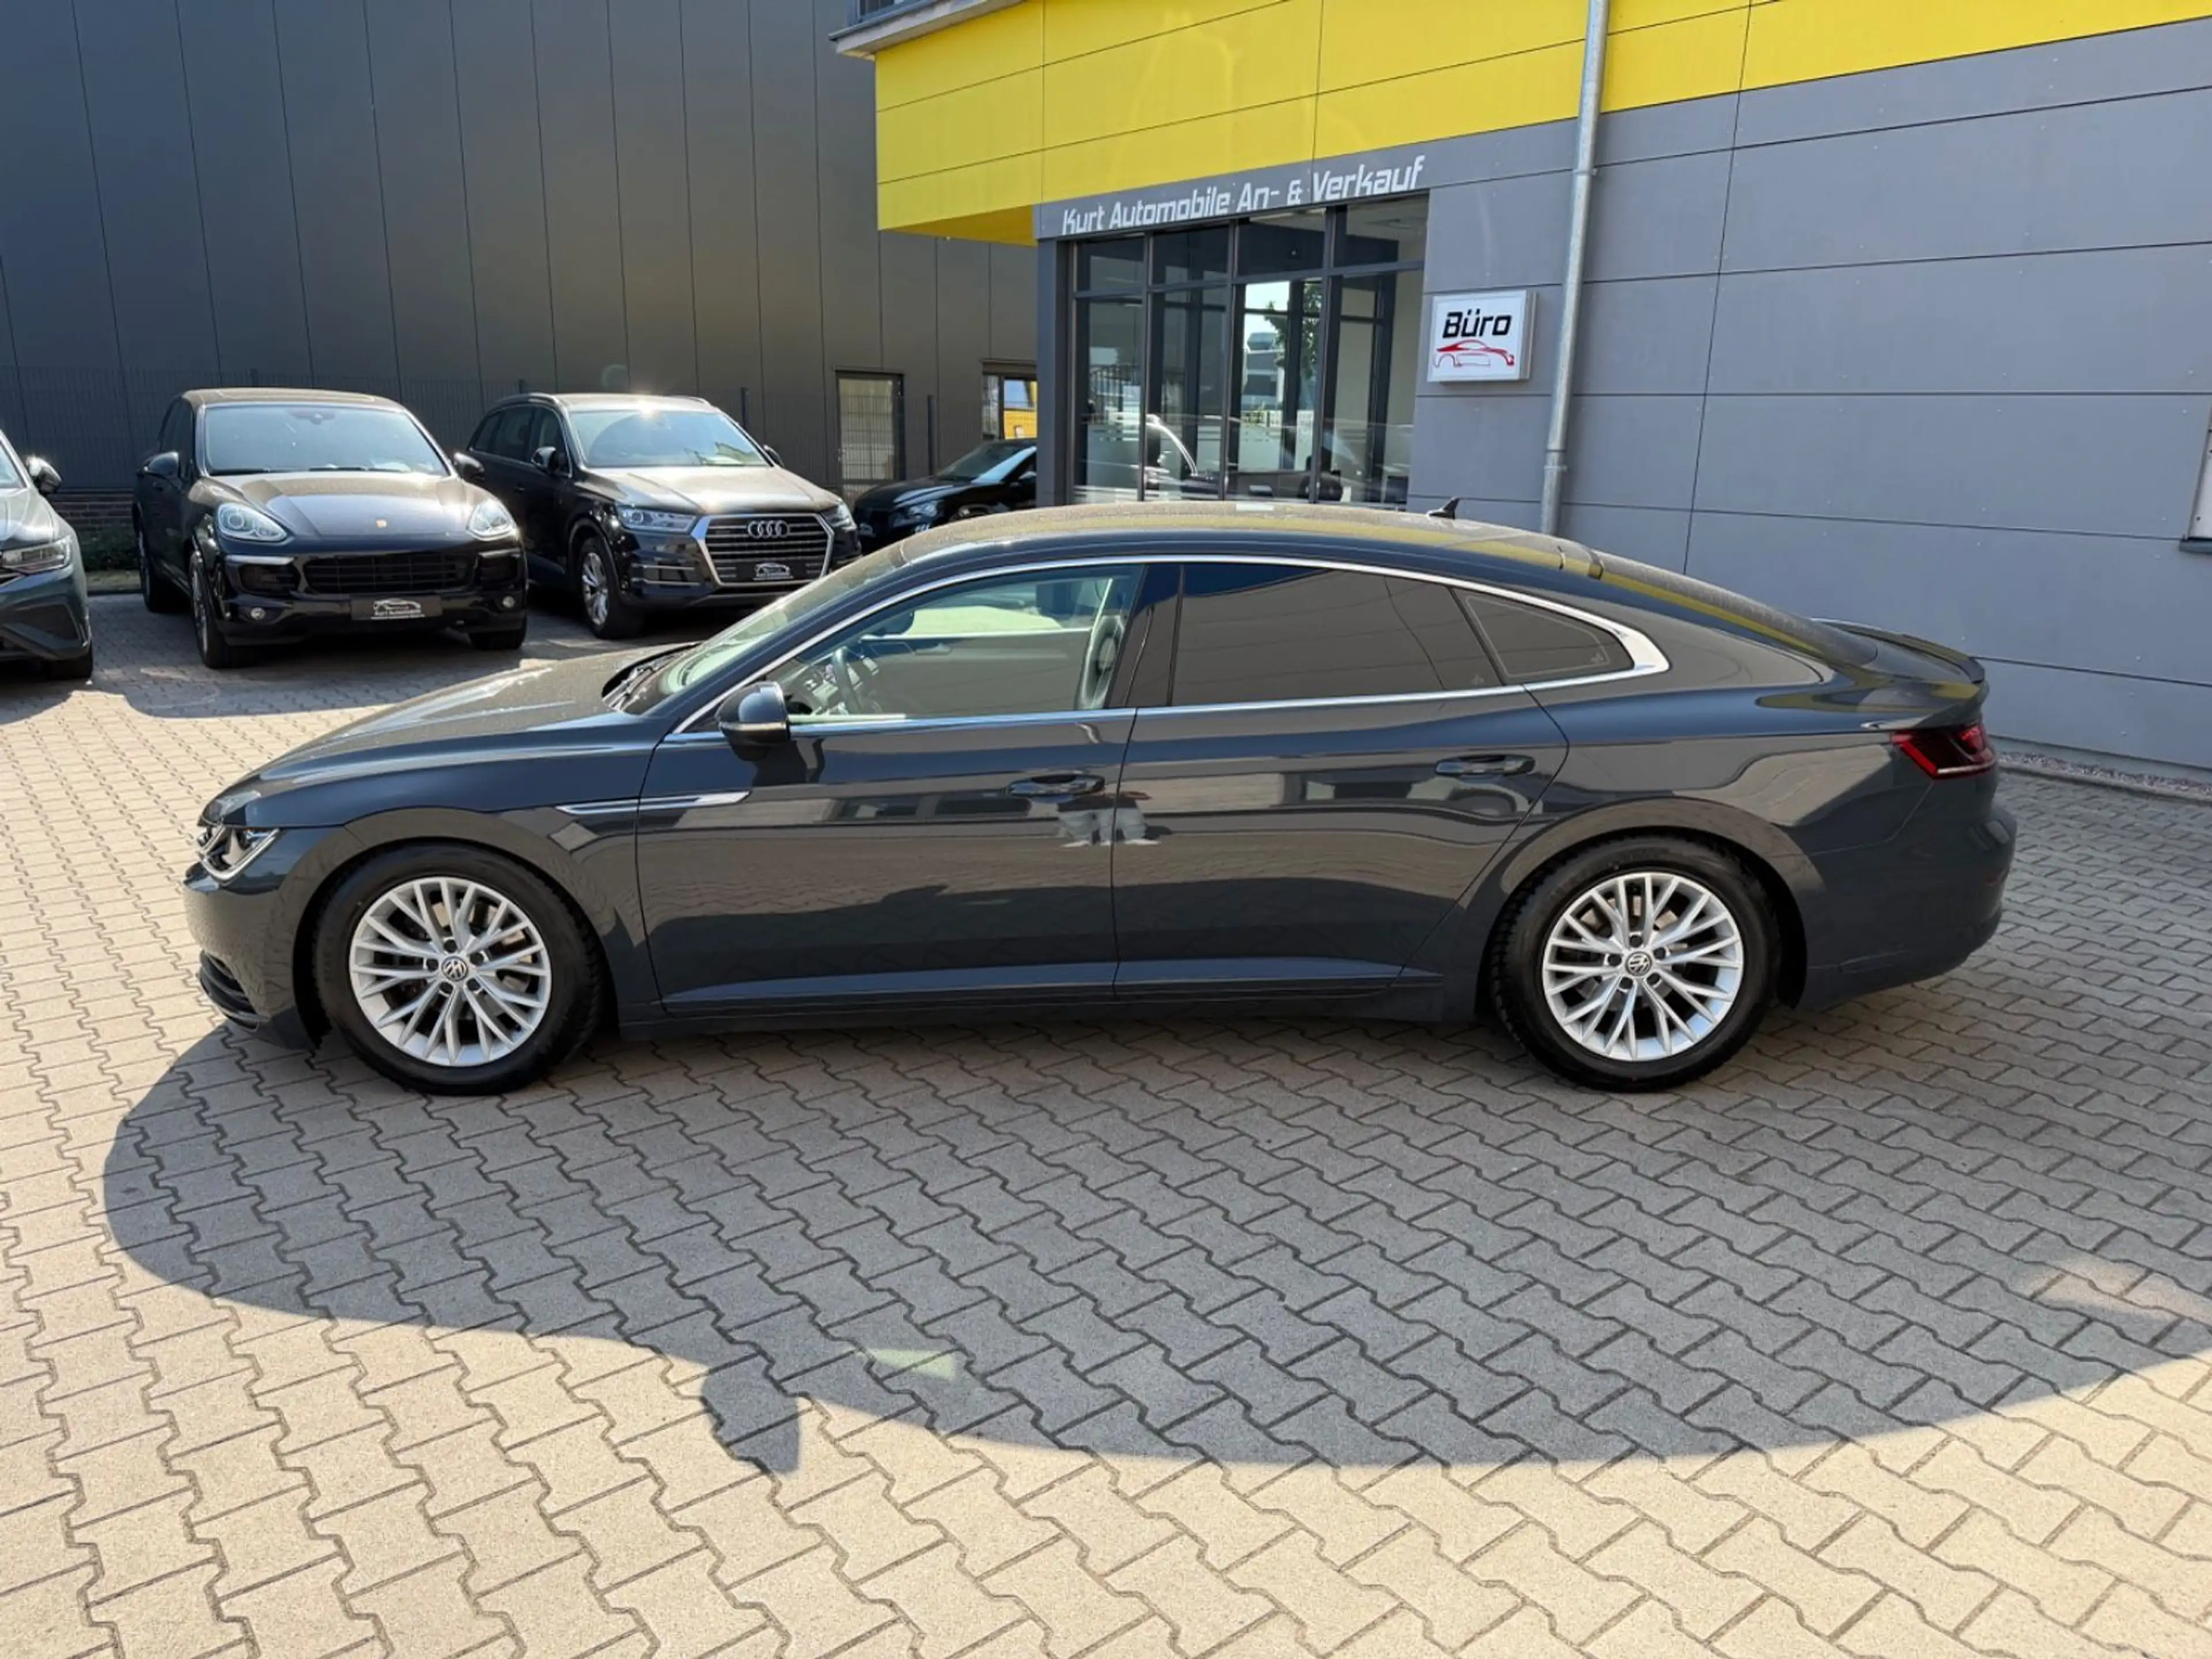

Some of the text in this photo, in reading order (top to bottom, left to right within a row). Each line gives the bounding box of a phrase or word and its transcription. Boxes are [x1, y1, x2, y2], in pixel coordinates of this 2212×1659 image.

[1062, 155, 1425, 235] Kurt Automobile An- & Verkauf
[1442, 308, 1512, 338] Büro
